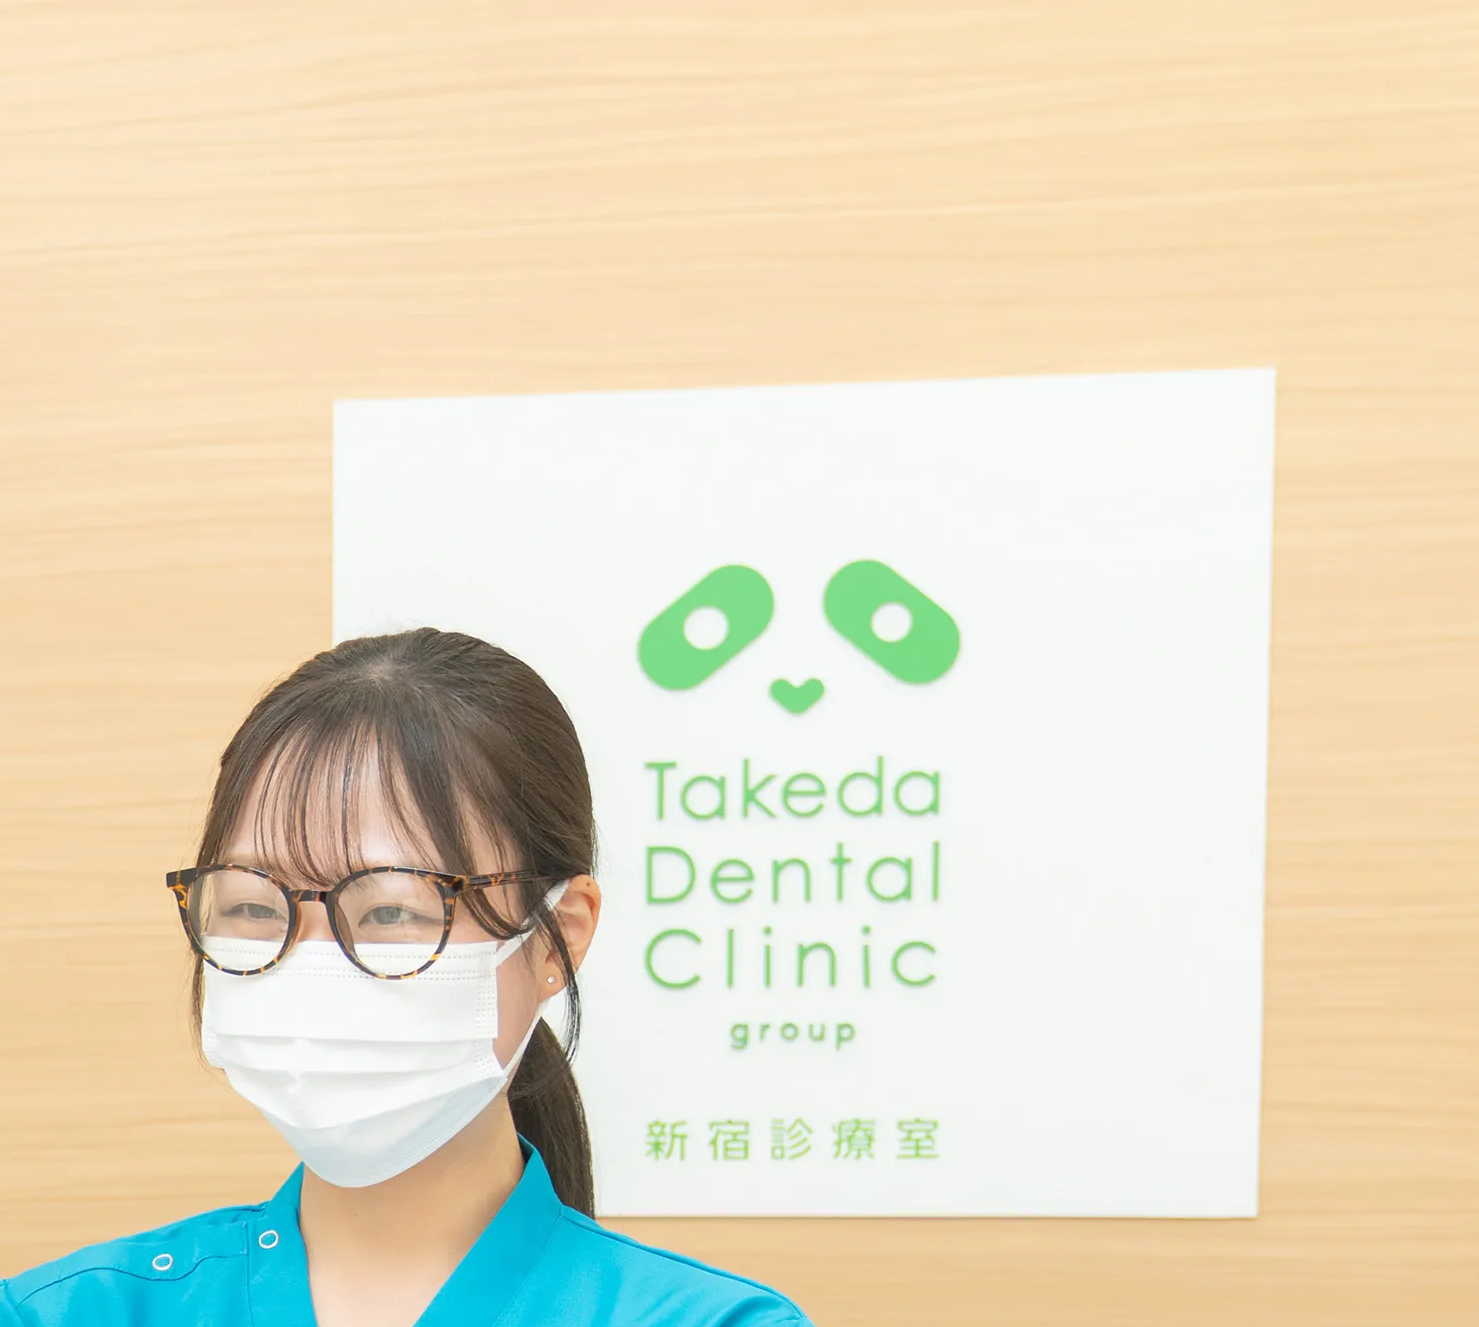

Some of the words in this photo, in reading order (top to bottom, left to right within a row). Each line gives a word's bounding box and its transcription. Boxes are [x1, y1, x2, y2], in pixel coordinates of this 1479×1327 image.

[644, 755, 942, 822] Takeda
[645, 839, 941, 906] Dental
[644, 924, 937, 991] Clinic
[729, 1021, 857, 1052] group
[645, 1116, 940, 1162] 新宿診療室
